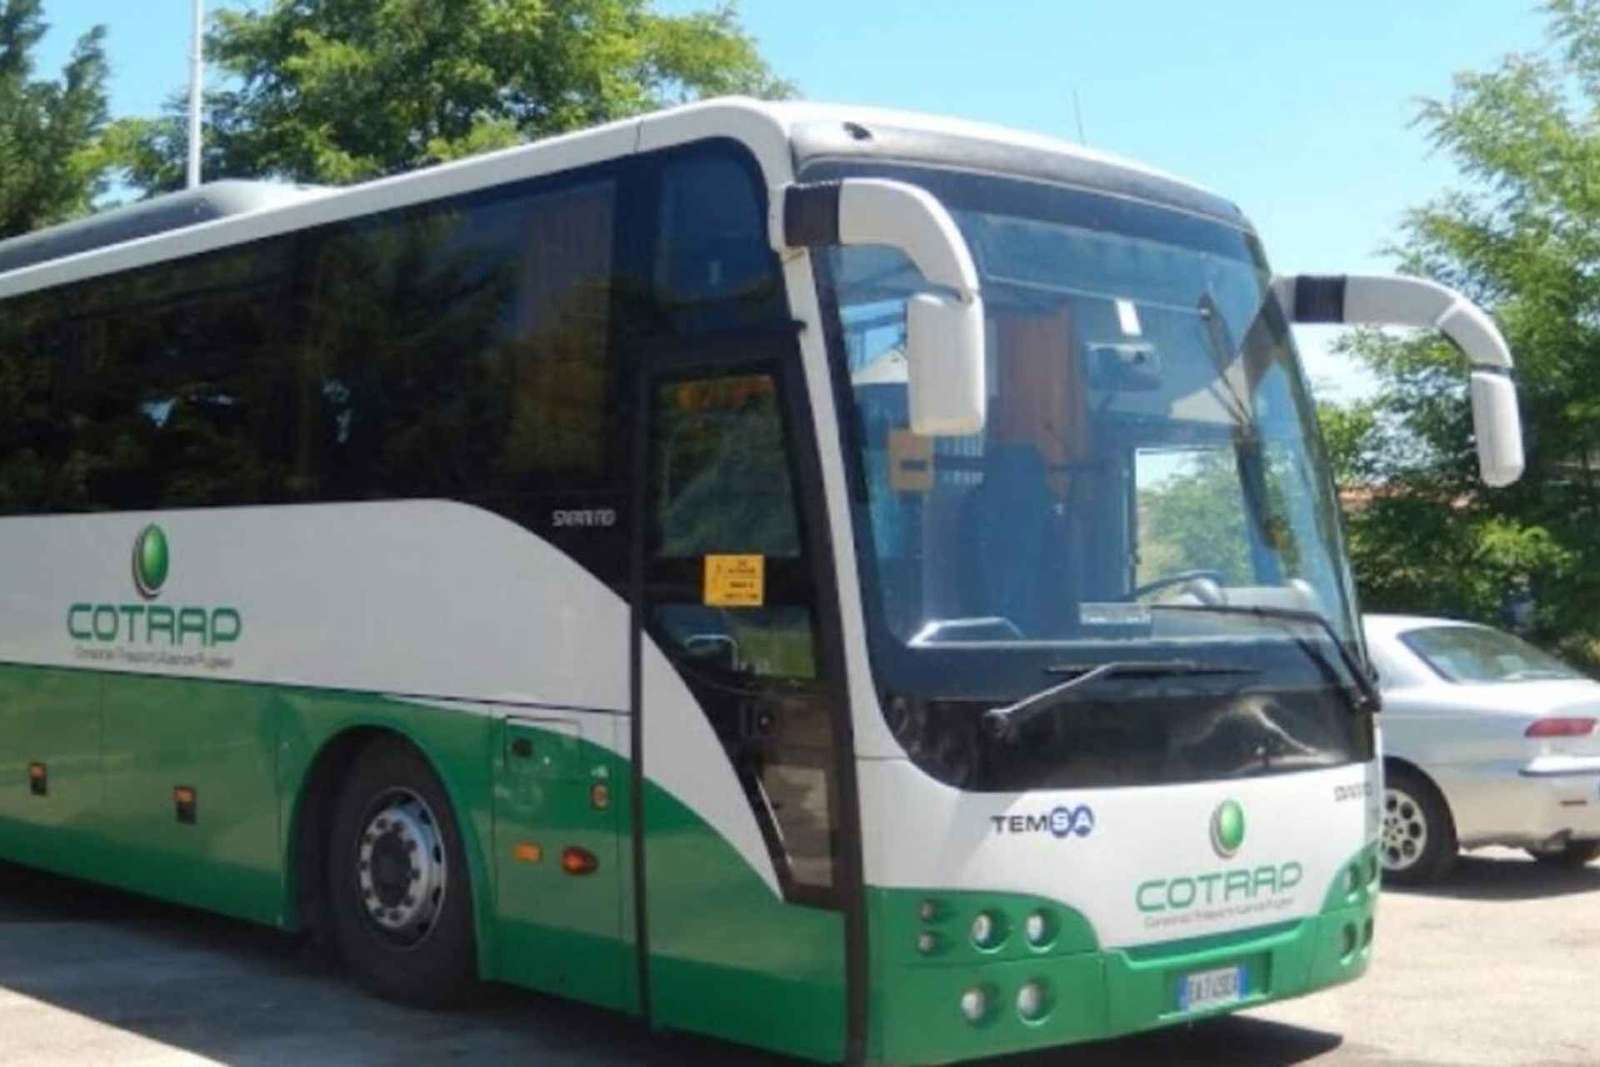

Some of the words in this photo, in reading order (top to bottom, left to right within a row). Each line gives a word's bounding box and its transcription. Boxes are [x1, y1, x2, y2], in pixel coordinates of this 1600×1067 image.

[67, 603, 242, 646] COTRAP
[989, 804, 1094, 839] TEMSA
[1135, 861, 1303, 913] COTRAP
